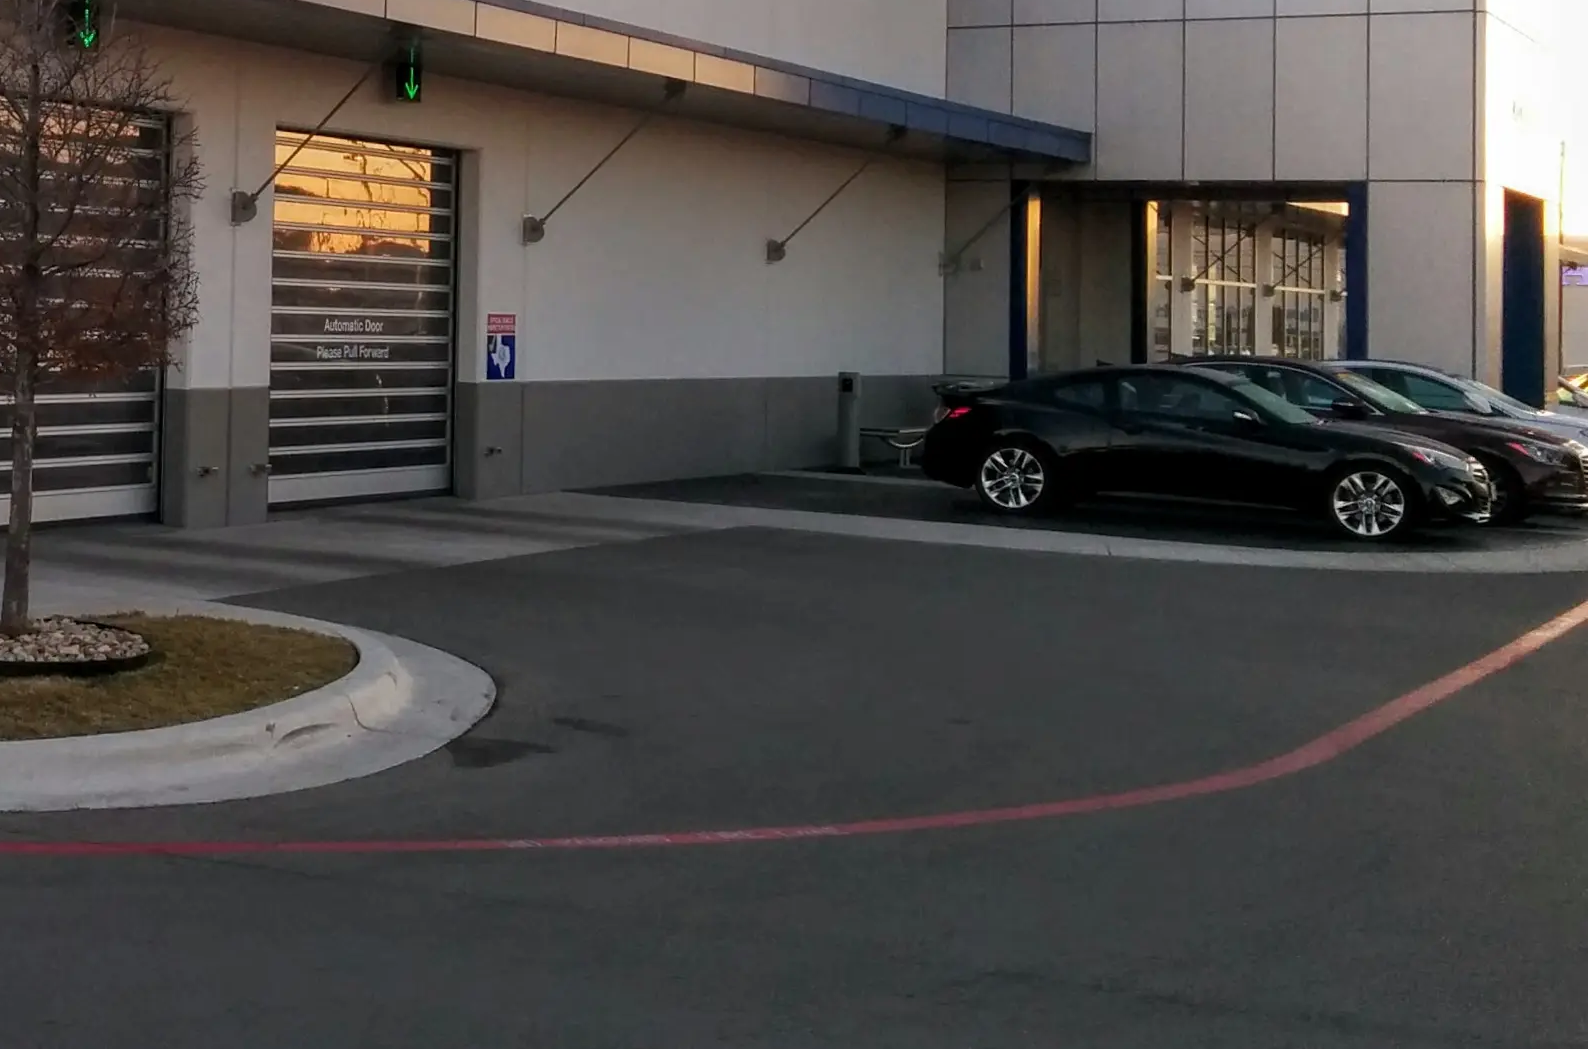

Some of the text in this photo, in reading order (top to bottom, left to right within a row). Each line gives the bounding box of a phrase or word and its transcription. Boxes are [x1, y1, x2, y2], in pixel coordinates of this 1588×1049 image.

[323, 318, 384, 332] Automatic Door
[316, 344, 390, 359] Please Pull Forward
